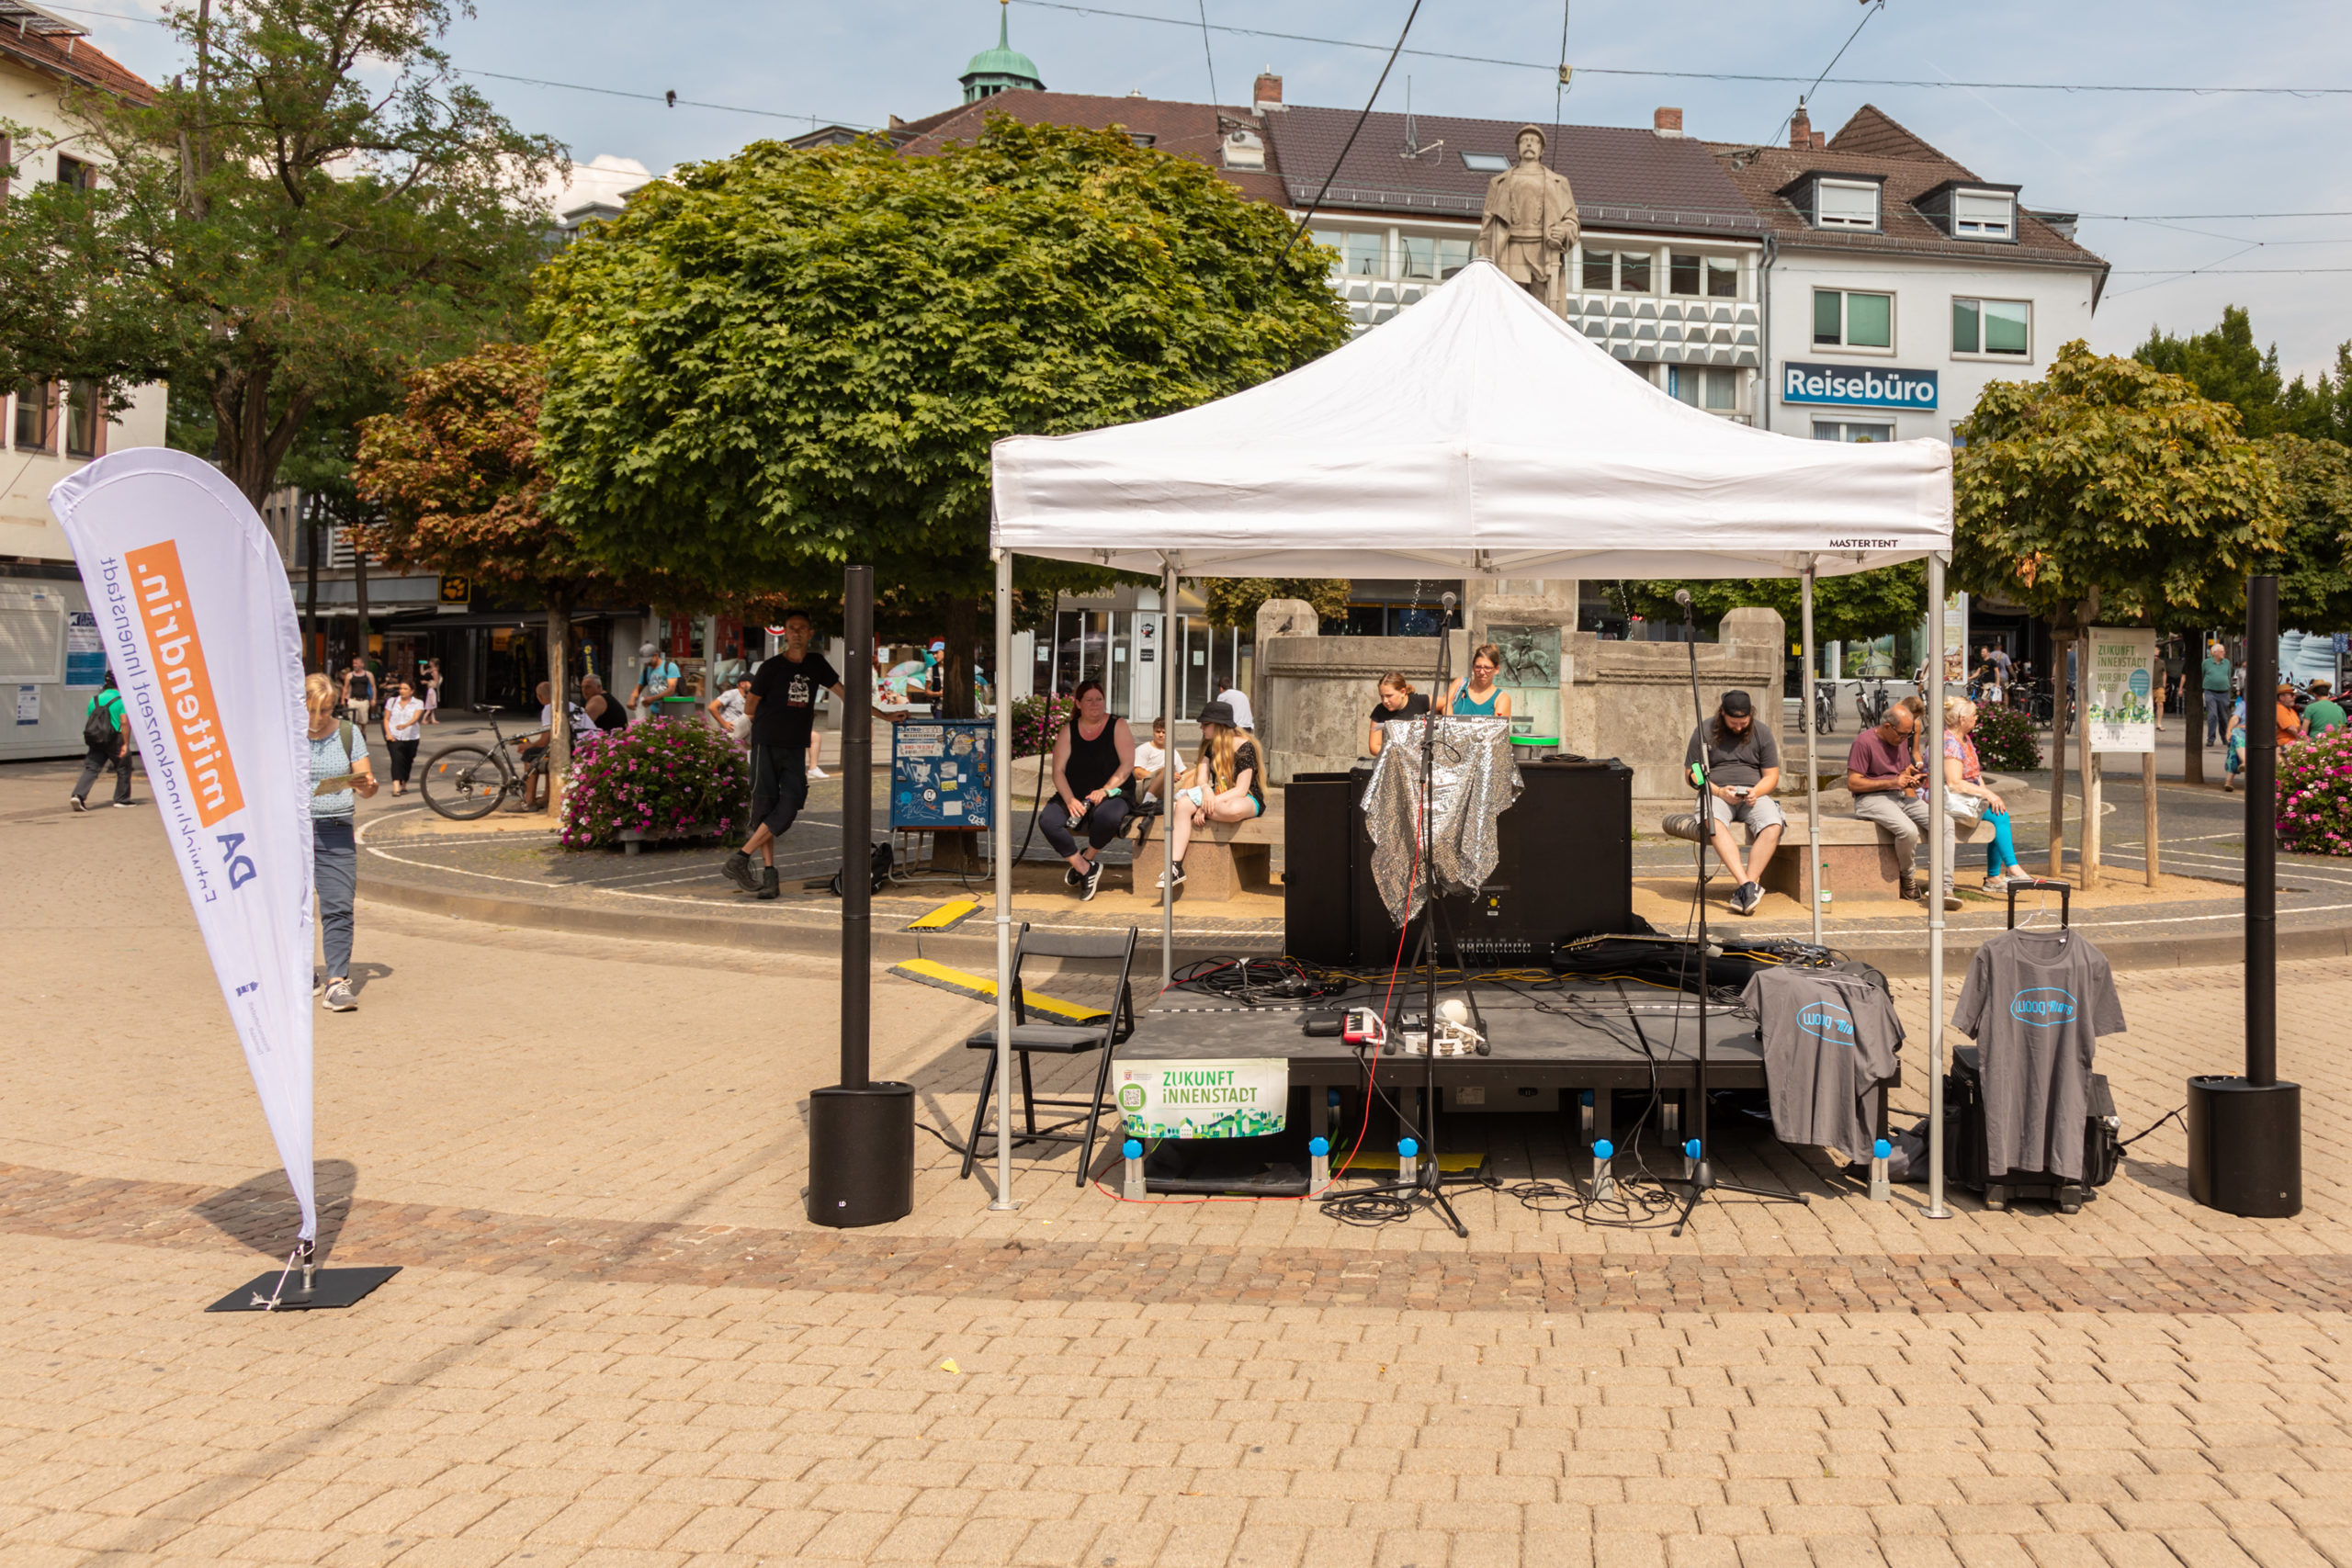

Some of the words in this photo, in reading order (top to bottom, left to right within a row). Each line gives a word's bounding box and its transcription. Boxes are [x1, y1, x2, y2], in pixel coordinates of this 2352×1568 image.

[1787, 368, 1935, 402] Reisebüro
[1829, 538, 1898, 548] MASTERTENT
[2098, 645, 2136, 656] ZUKUNFT
[2097, 672, 2111, 682] WIR
[2113, 672, 2128, 682] SIND
[1163, 1070, 1235, 1087] ZUKUNFT
